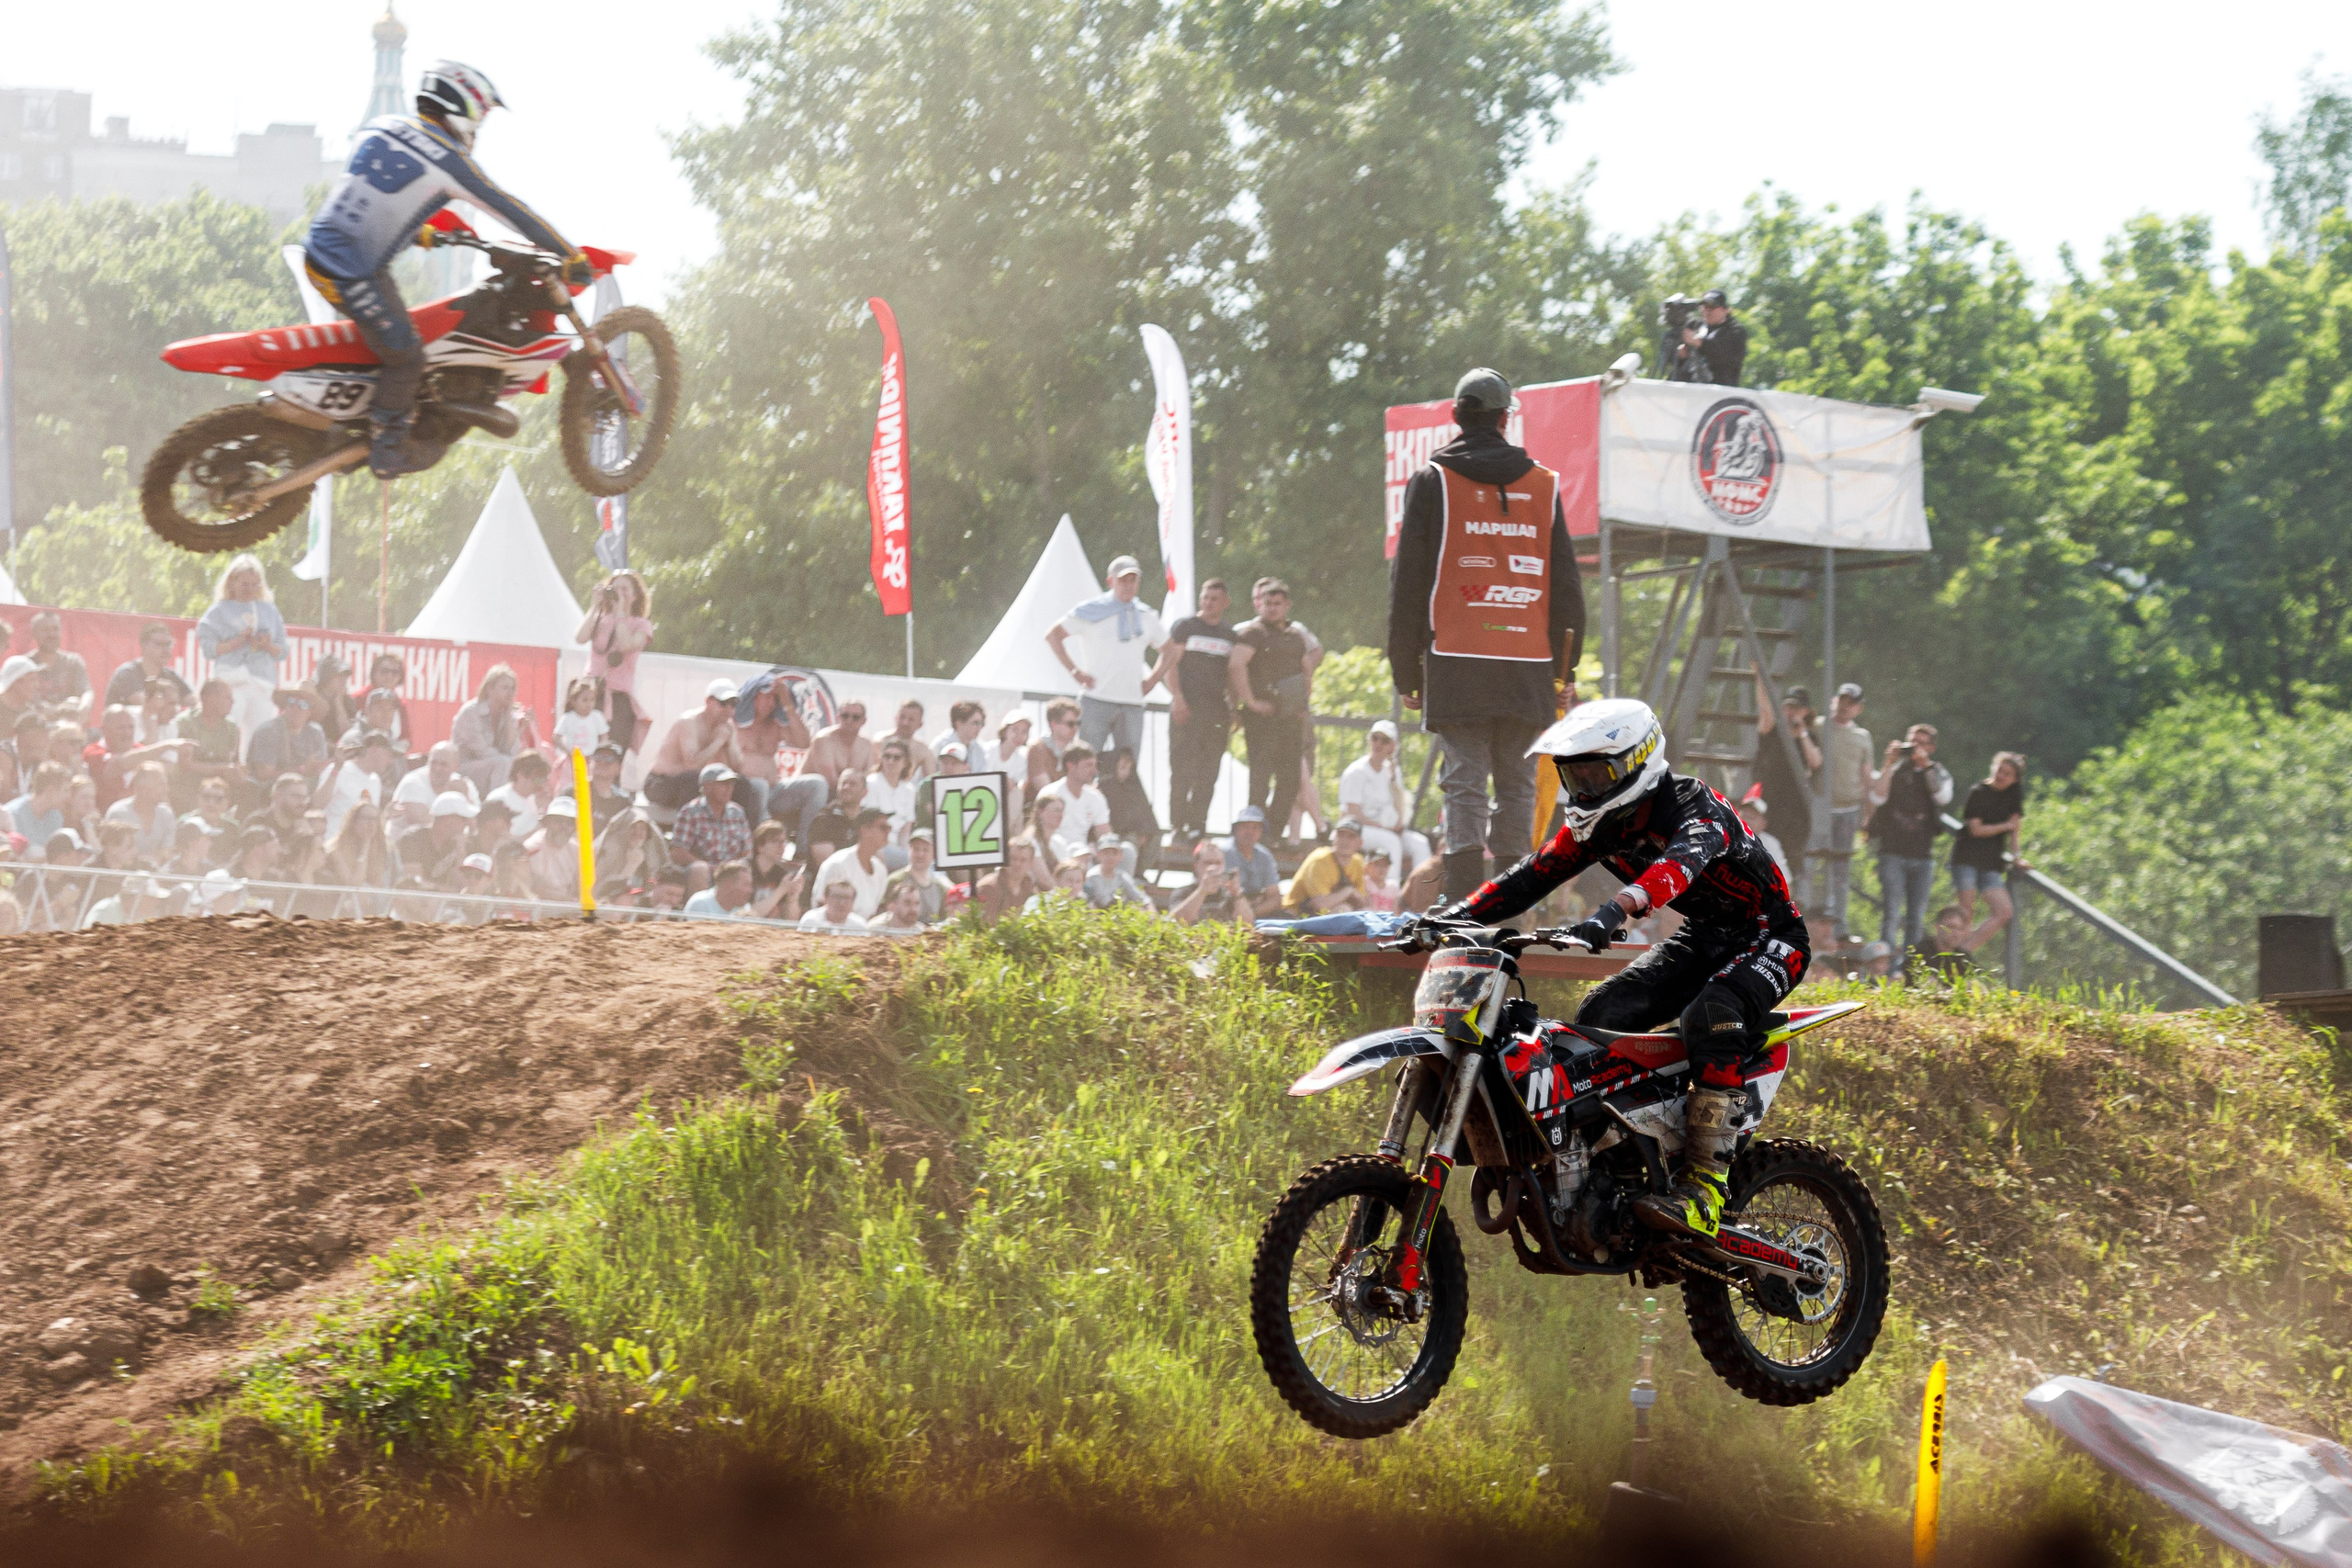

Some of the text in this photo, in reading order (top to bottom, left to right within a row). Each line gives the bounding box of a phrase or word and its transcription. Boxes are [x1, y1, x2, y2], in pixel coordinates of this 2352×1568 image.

[319, 381, 367, 410] 89
[1464, 521, 1537, 538] МАРШАЛ
[1484, 584, 1543, 604] RGP
[939, 785, 999, 855] 12
[1572, 1063, 1633, 1094] MotoAcademy
[1715, 1230, 1799, 1271] Academy
